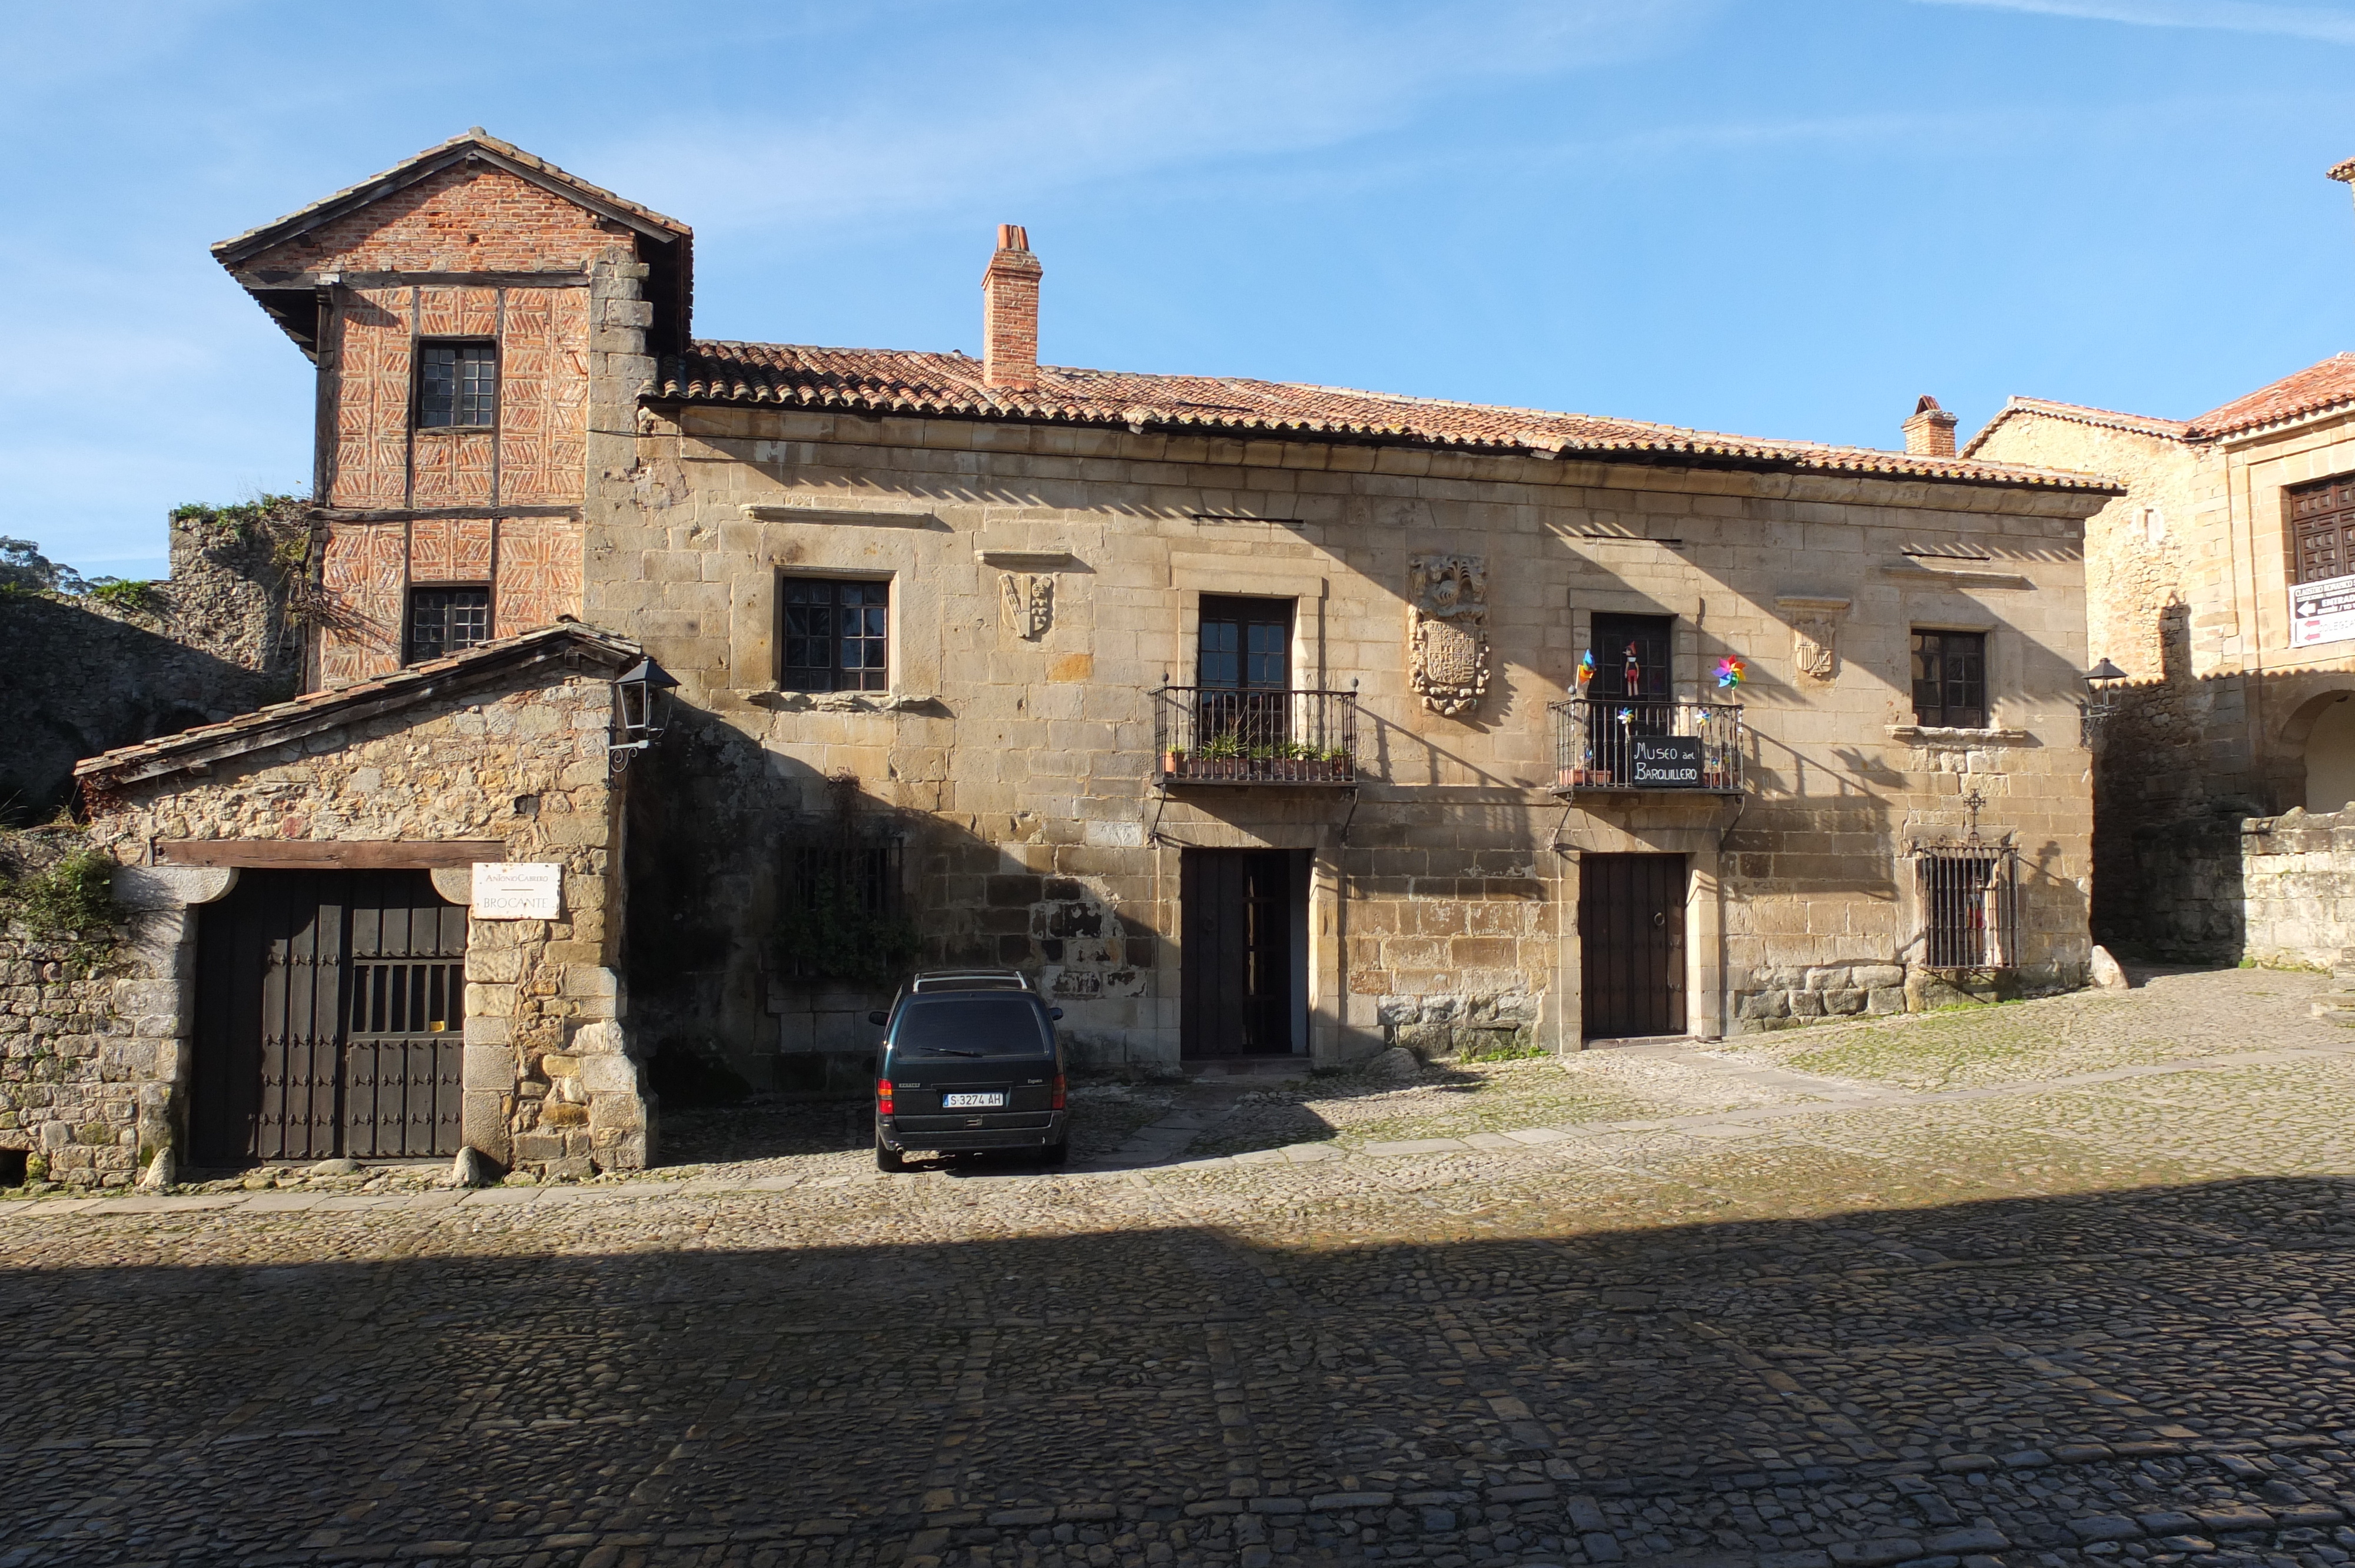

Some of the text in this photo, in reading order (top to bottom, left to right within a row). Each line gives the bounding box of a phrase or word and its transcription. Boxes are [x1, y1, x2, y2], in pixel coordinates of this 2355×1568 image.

[2318, 619, 2355, 633] COLEGIA
[1634, 742, 1677, 760] MUSEO
[1634, 762, 1697, 780] BARQUILLERO
[484, 898, 548, 908] BROCANTE
[988, 1094, 1001, 1104] AH
